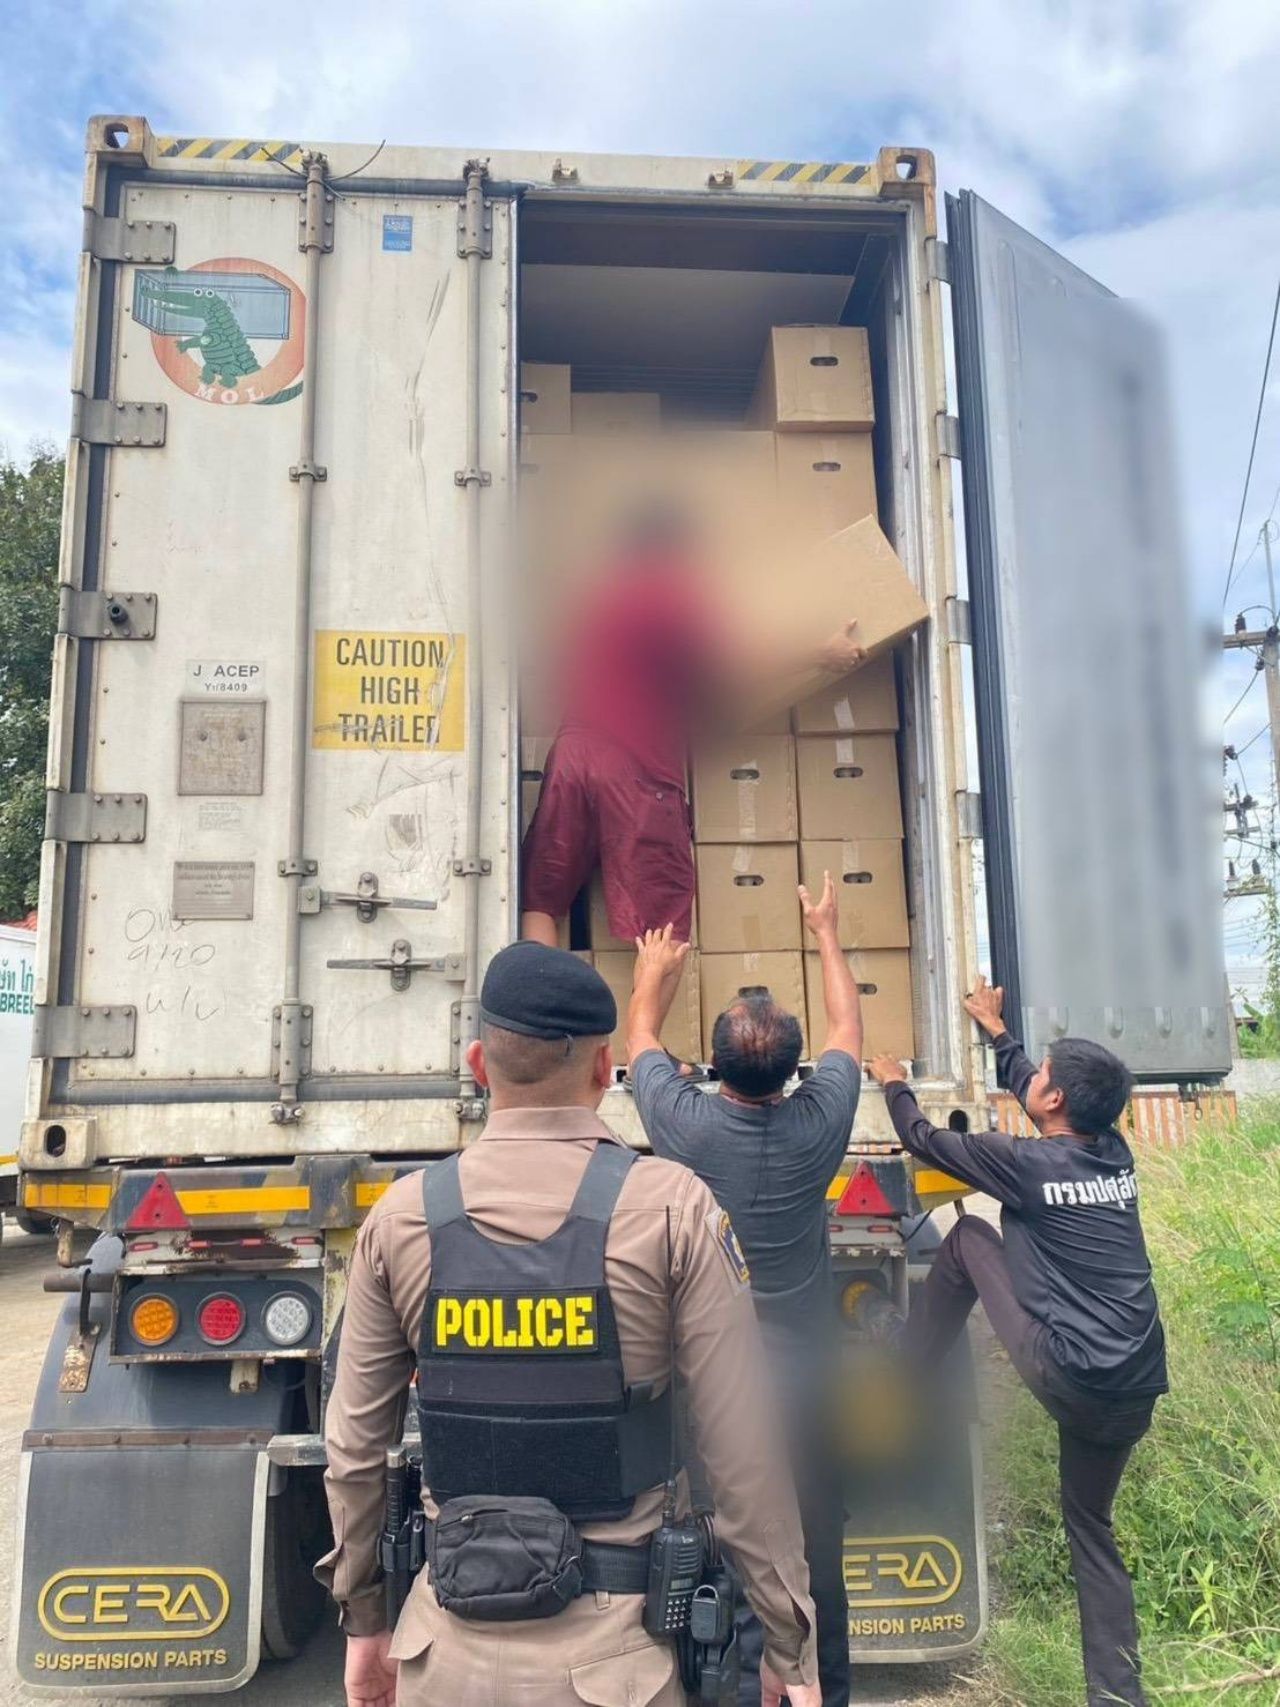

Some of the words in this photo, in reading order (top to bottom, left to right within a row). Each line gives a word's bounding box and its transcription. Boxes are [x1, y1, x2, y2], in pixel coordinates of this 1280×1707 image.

[194, 384, 265, 404] MOL
[336, 638, 444, 668] CAUTION
[214, 665, 260, 677] ACEP
[360, 676, 419, 705] HIGH
[338, 713, 440, 744] TRAILER
[436, 1296, 594, 1348] POLICE
[843, 1551, 949, 1591] ERA
[53, 1583, 213, 1624] CERA
[848, 1617, 905, 1636] NSION
[910, 1613, 967, 1633] PARTS
[34, 1651, 159, 1671] SUSPENSION
[164, 1648, 228, 1668] PARTS
